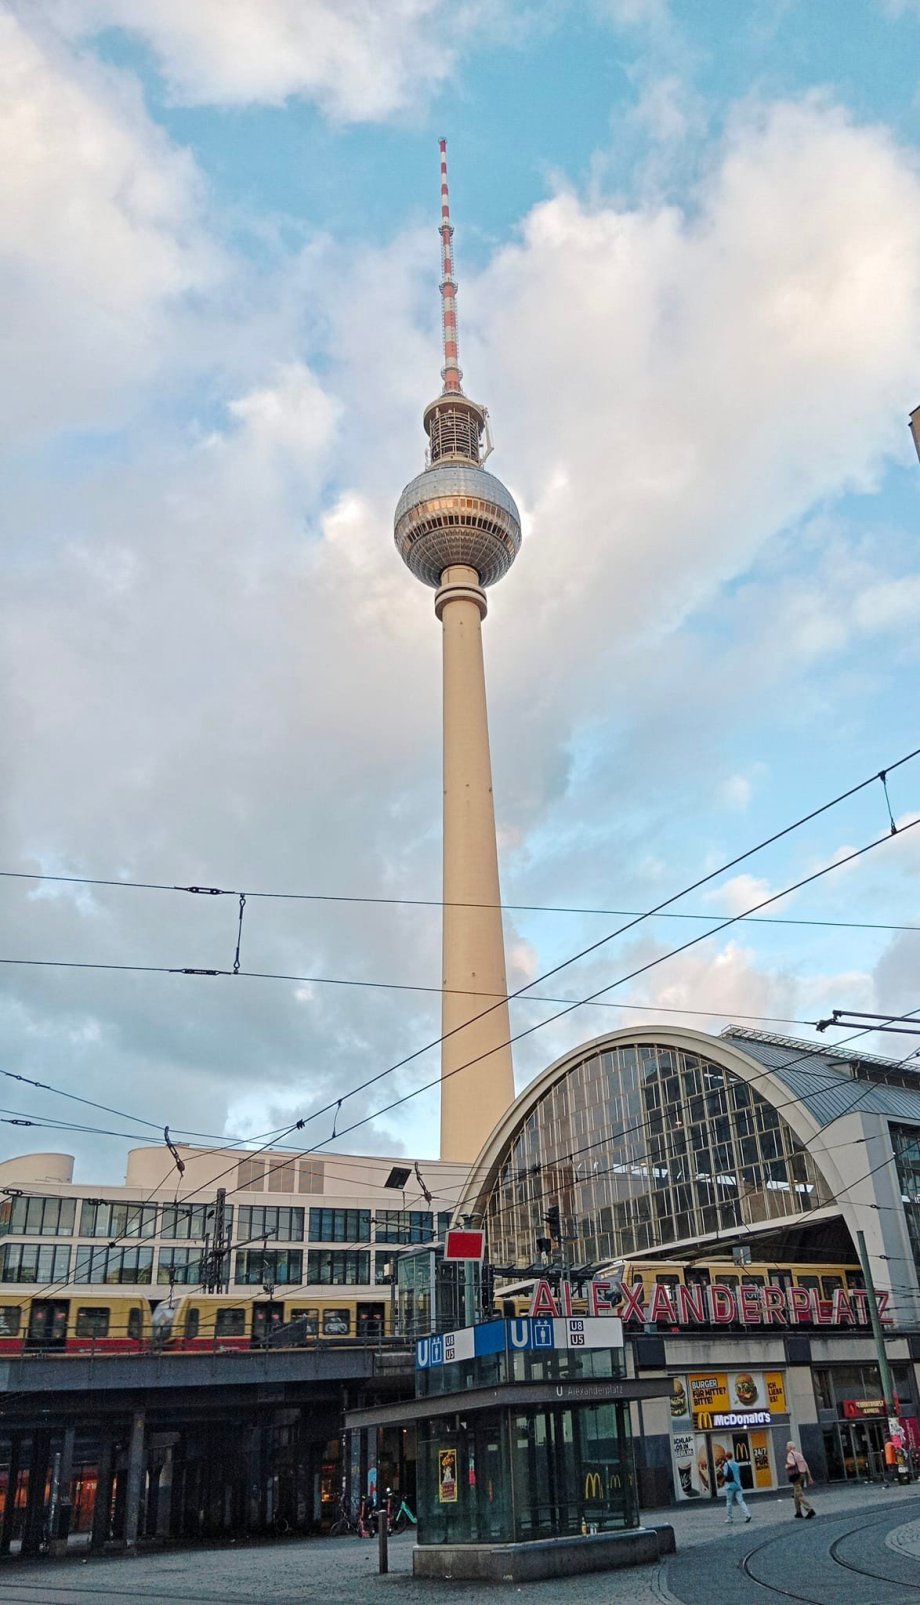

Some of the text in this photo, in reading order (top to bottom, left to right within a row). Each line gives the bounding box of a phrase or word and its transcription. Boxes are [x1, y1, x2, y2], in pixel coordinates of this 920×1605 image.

[530, 1279, 893, 1325] ALEXANDERPLATZ
[570, 1321, 583, 1331] U8
[510, 1320, 528, 1348] U
[571, 1334, 584, 1345] U5
[418, 1340, 428, 1367] U
[446, 1349, 454, 1359] U5
[691, 1378, 718, 1390] BURGER
[556, 1385, 563, 1397] U
[713, 1411, 771, 1426] McDonald's
